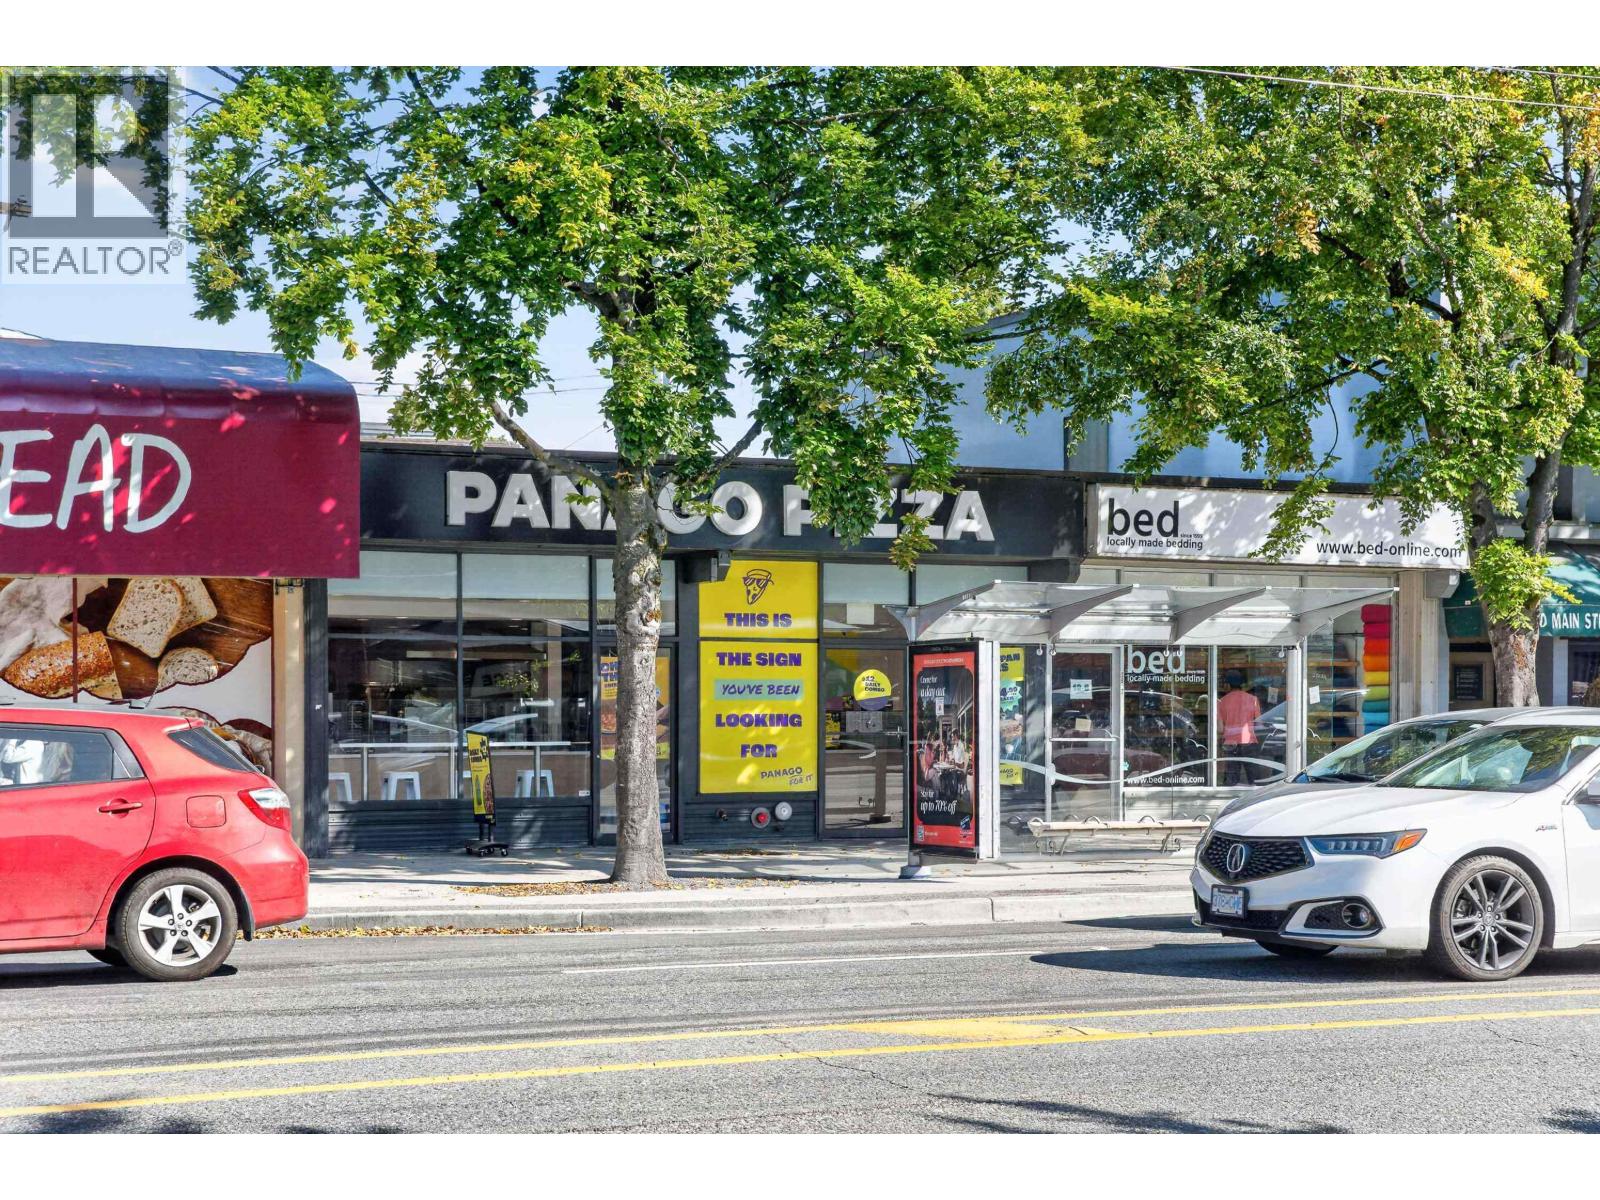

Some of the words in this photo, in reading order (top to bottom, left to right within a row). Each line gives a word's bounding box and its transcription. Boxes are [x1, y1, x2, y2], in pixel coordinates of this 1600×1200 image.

[446, 470, 763, 536] PANGO
[783, 484, 995, 541] PZZA
[1108, 498, 1180, 538] bed
[1106, 537, 1136, 549] locally
[1138, 539, 1164, 548] made
[1166, 539, 1204, 551] bedding
[1316, 540, 1462, 559] www.bed-online.com
[724, 613, 769, 627] THIS
[773, 613, 792, 627] IS
[1551, 612, 1580, 629] MAIN
[1584, 612, 1600, 630] ST
[716, 652, 752, 666] THE
[756, 653, 802, 667] SIGN
[1127, 645, 1185, 674] bed
[1127, 674, 1151, 684] locally
[1152, 675, 1174, 683] made
[1174, 674, 1205, 684] bedding
[722, 684, 763, 695] YOU'VE
[767, 684, 800, 695] BEEN
[715, 714, 802, 728] LOOKING
[740, 744, 778, 758] FOR
[760, 767, 802, 779] PANAGO
